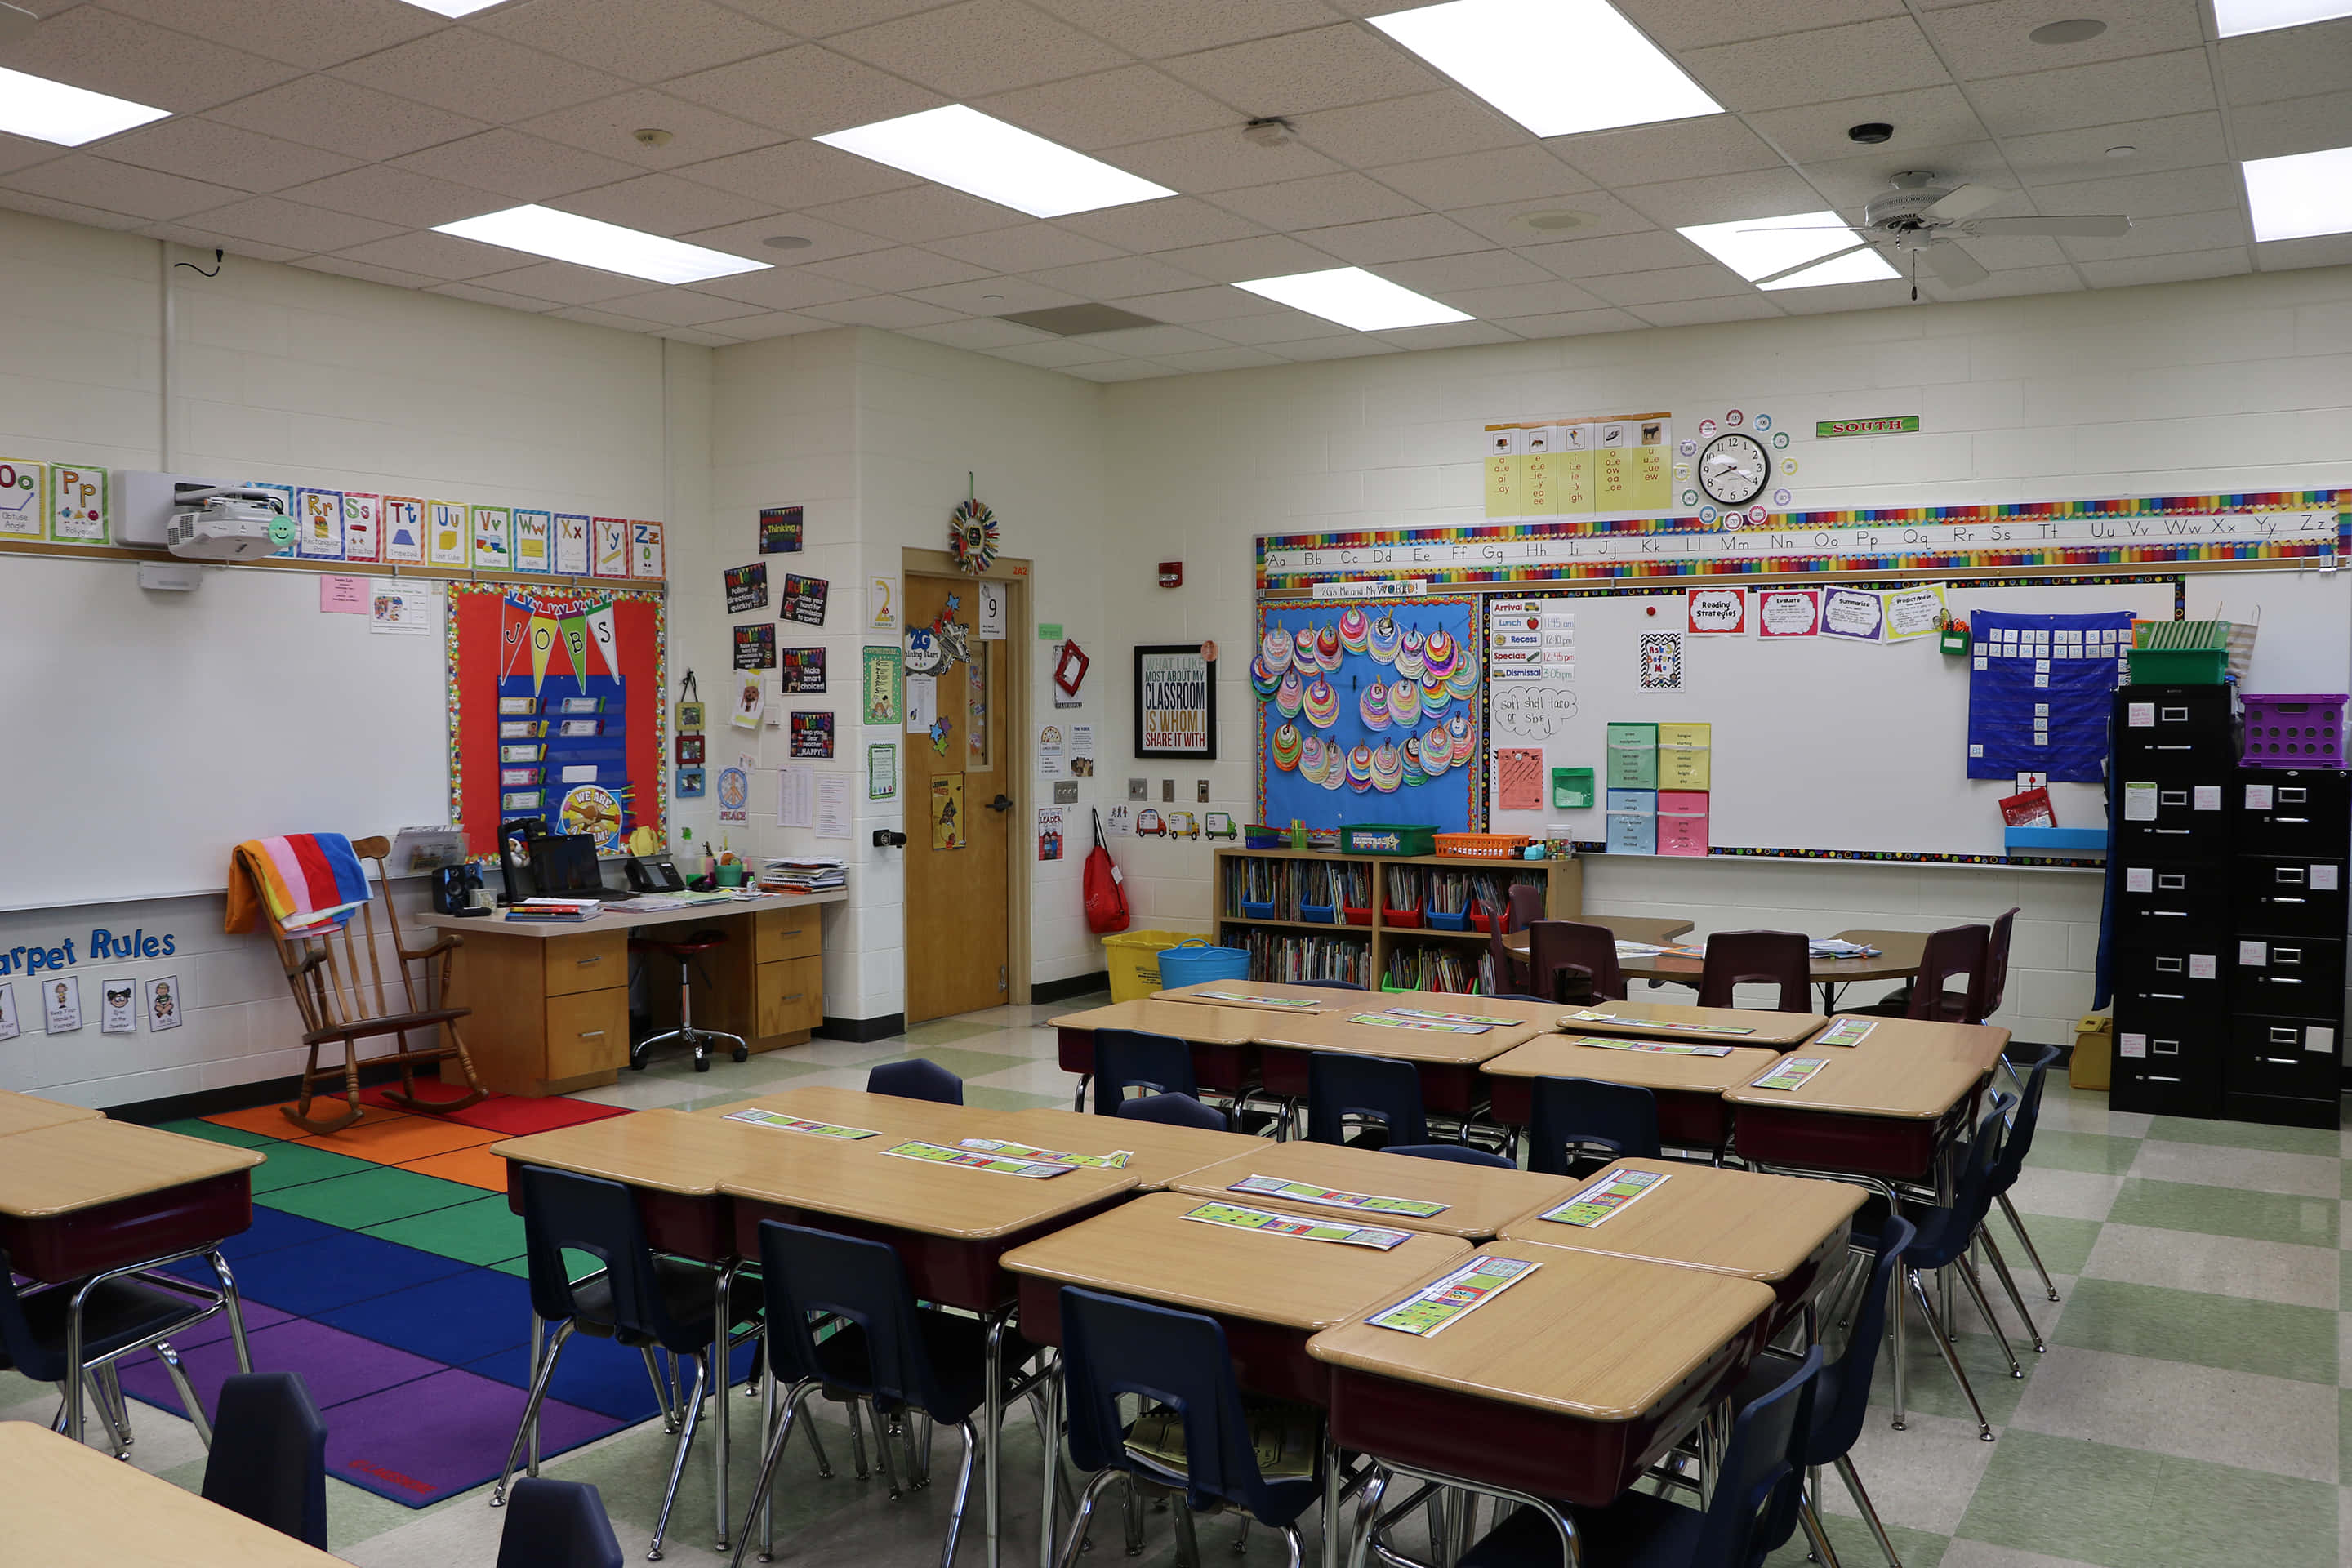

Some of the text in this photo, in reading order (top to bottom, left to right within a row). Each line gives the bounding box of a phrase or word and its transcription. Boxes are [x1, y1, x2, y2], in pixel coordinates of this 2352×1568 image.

[1833, 421, 1902, 433] SOUTH
[1729, 438, 1738, 447] 12
[1706, 453, 1714, 461] 10
[1753, 451, 1757, 459] 2
[1757, 464, 1762, 472] 3
[63, 471, 96, 508] Pp
[1708, 479, 1713, 487] 8
[1569, 493, 1582, 503] igh
[1731, 492, 1735, 500] 6
[1744, 488, 1748, 496] 5
[307, 495, 332, 516] Rr
[345, 498, 369, 519] Ss
[390, 503, 417, 523] Tt
[438, 507, 459, 527] Uu
[480, 511, 501, 530] Vv
[519, 514, 545, 536] Ww
[562, 520, 581, 539] Xx
[635, 525, 660, 544] Zz
[768, 524, 795, 533] Thinking
[602, 523, 620, 550] Yy
[1268, 514, 2324, 567] Aa Bb Cc Dd Ee Ff Gg Hh Ii Jj Kk Ll Mm Nn Oo Pp Qq Rr Ss Tt Uu Vv Ww Xx Yy Zz
[1013, 567, 1027, 575] 2A2
[787, 581, 810, 594] Rule
[1340, 586, 1349, 595] Me
[1351, 586, 1363, 595] and
[1366, 586, 1375, 598] My
[875, 581, 890, 621] 2
[1702, 602, 1731, 611] Reading
[1839, 598, 1870, 607] Summarize
[989, 599, 996, 617] 9
[1697, 610, 1735, 620] Strategies
[506, 622, 610, 653] JOBS
[737, 630, 759, 644] Rule
[910, 629, 930, 650] 2G
[2122, 631, 2130, 639] 10
[785, 653, 808, 666] Rule
[1146, 658, 1204, 670] WHAT I LIKE
[1655, 664, 1667, 672] Me
[1146, 671, 1204, 682] MOST ABOUT MY
[1561, 672, 1572, 680] pm
[800, 682, 824, 690] choices!
[1146, 682, 1205, 710] CLASSROOM
[1501, 695, 1518, 709] soft
[1549, 697, 1569, 709] taco
[794, 716, 817, 730] Rule
[1146, 710, 1205, 732] IS WHOM I
[1146, 733, 1205, 747] SHARE IT WITH
[575, 791, 612, 808] WE ARE
[91, 929, 175, 959] Rules
